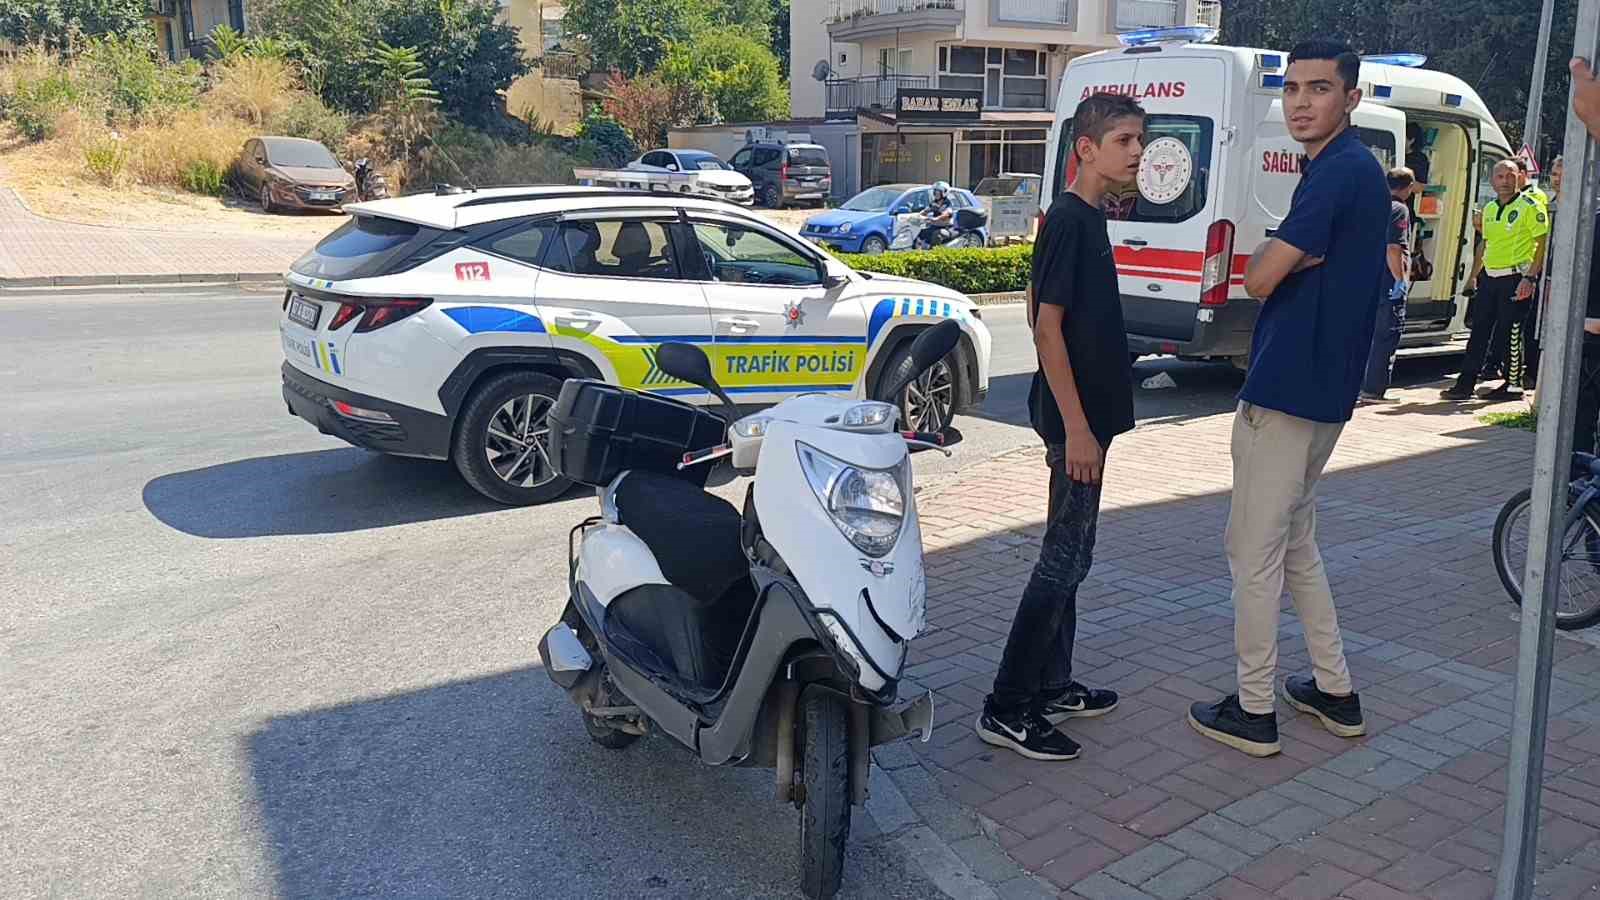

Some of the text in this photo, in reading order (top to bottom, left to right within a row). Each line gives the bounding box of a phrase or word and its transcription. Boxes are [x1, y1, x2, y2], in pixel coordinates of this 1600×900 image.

[1080, 82, 1185, 100] AMBULANS
[460, 264, 484, 281] 112
[726, 350, 854, 373] TRAFİK POLİSİ
